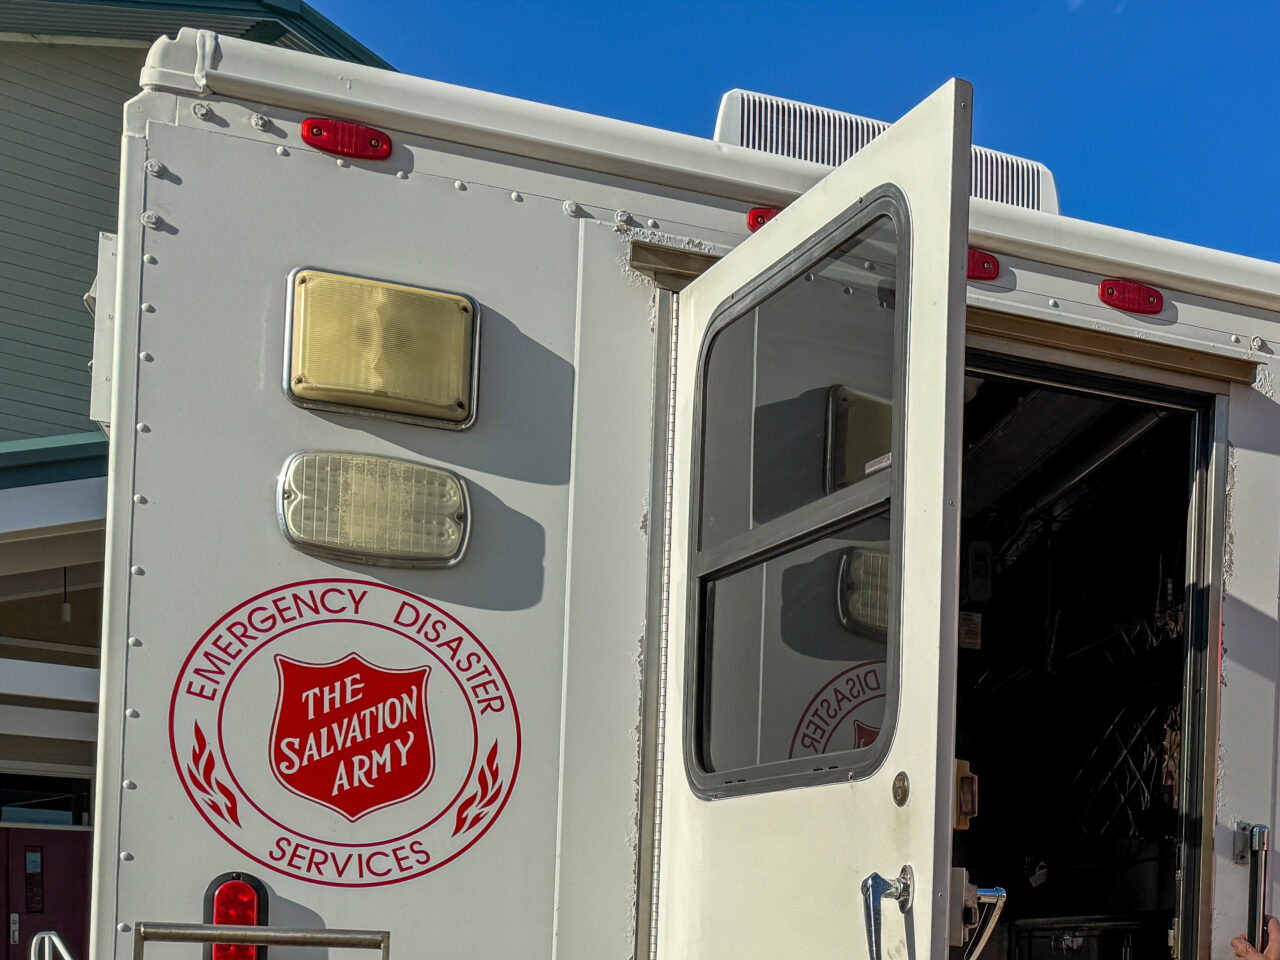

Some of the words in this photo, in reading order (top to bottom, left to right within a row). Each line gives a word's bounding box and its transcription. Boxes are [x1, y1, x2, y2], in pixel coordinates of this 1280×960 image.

[186, 588, 368, 701] EMERGENCY
[393, 601, 505, 715] DISASTER
[302, 674, 365, 720] THE
[279, 685, 418, 775] SALVATION
[331, 731, 414, 796] ARMY
[269, 836, 431, 878] SERVICES
